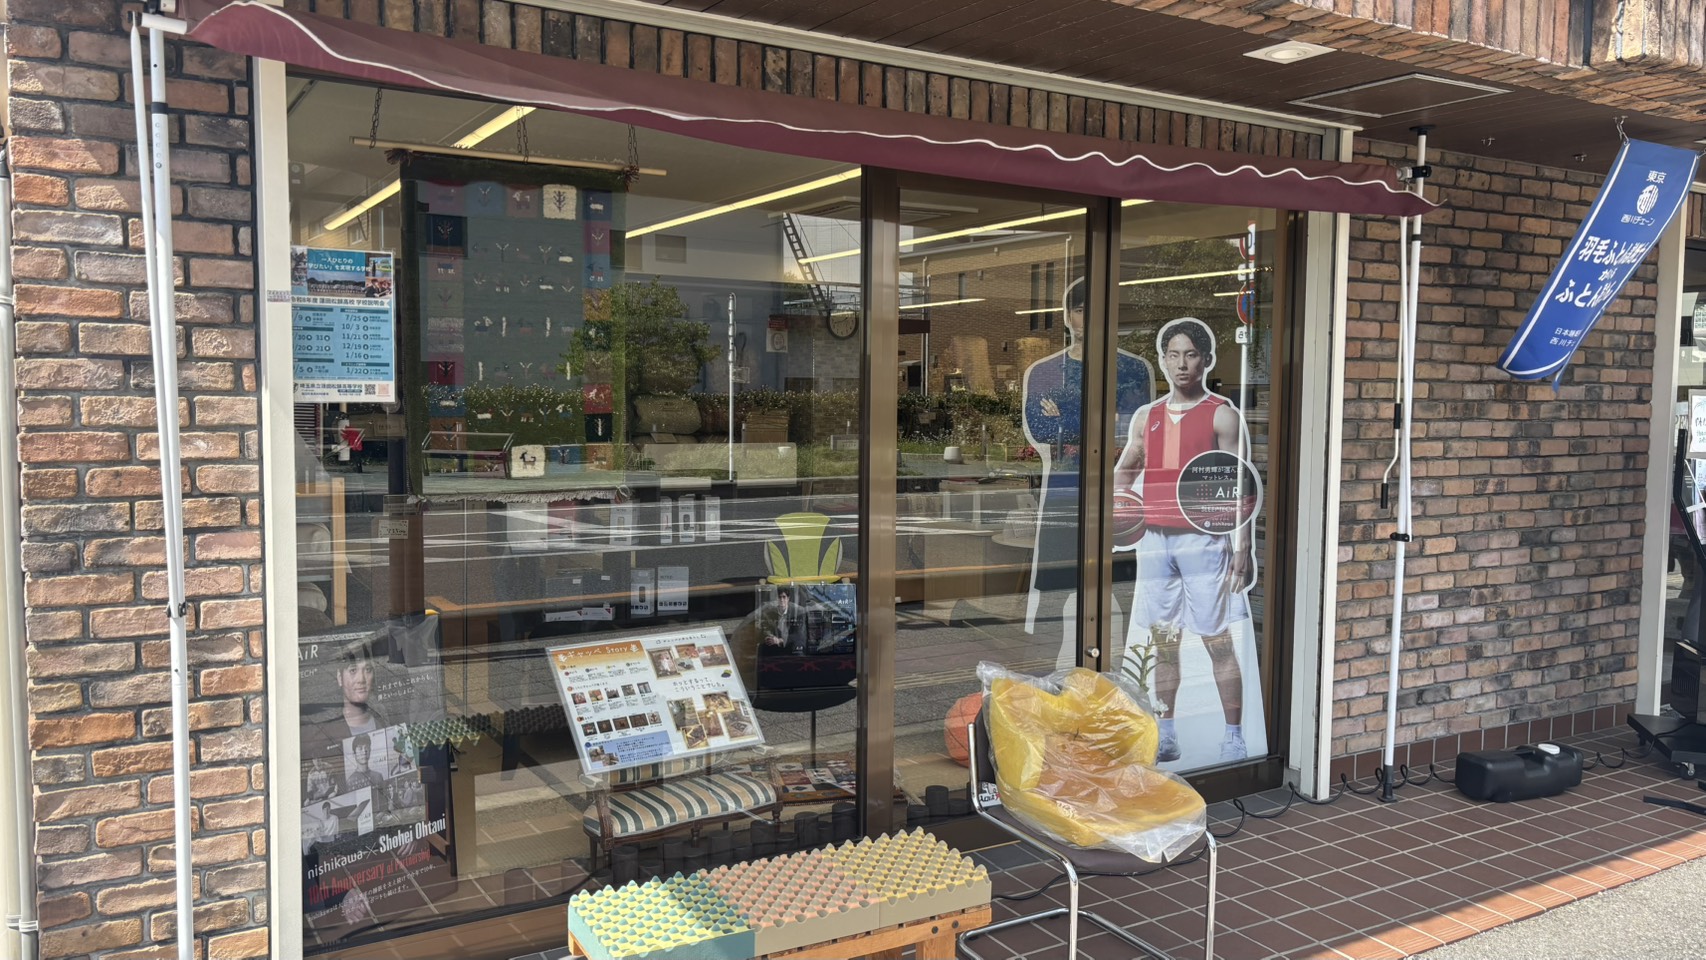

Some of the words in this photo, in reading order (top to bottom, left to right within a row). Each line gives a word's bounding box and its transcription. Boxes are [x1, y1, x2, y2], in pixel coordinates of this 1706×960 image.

[1646, 170, 1667, 184] 東京
[307, 850, 363, 880] nishikawa
[379, 825, 414, 853] Shohei
[415, 813, 446, 840] Ohtani
[331, 863, 386, 897] Anniversary
